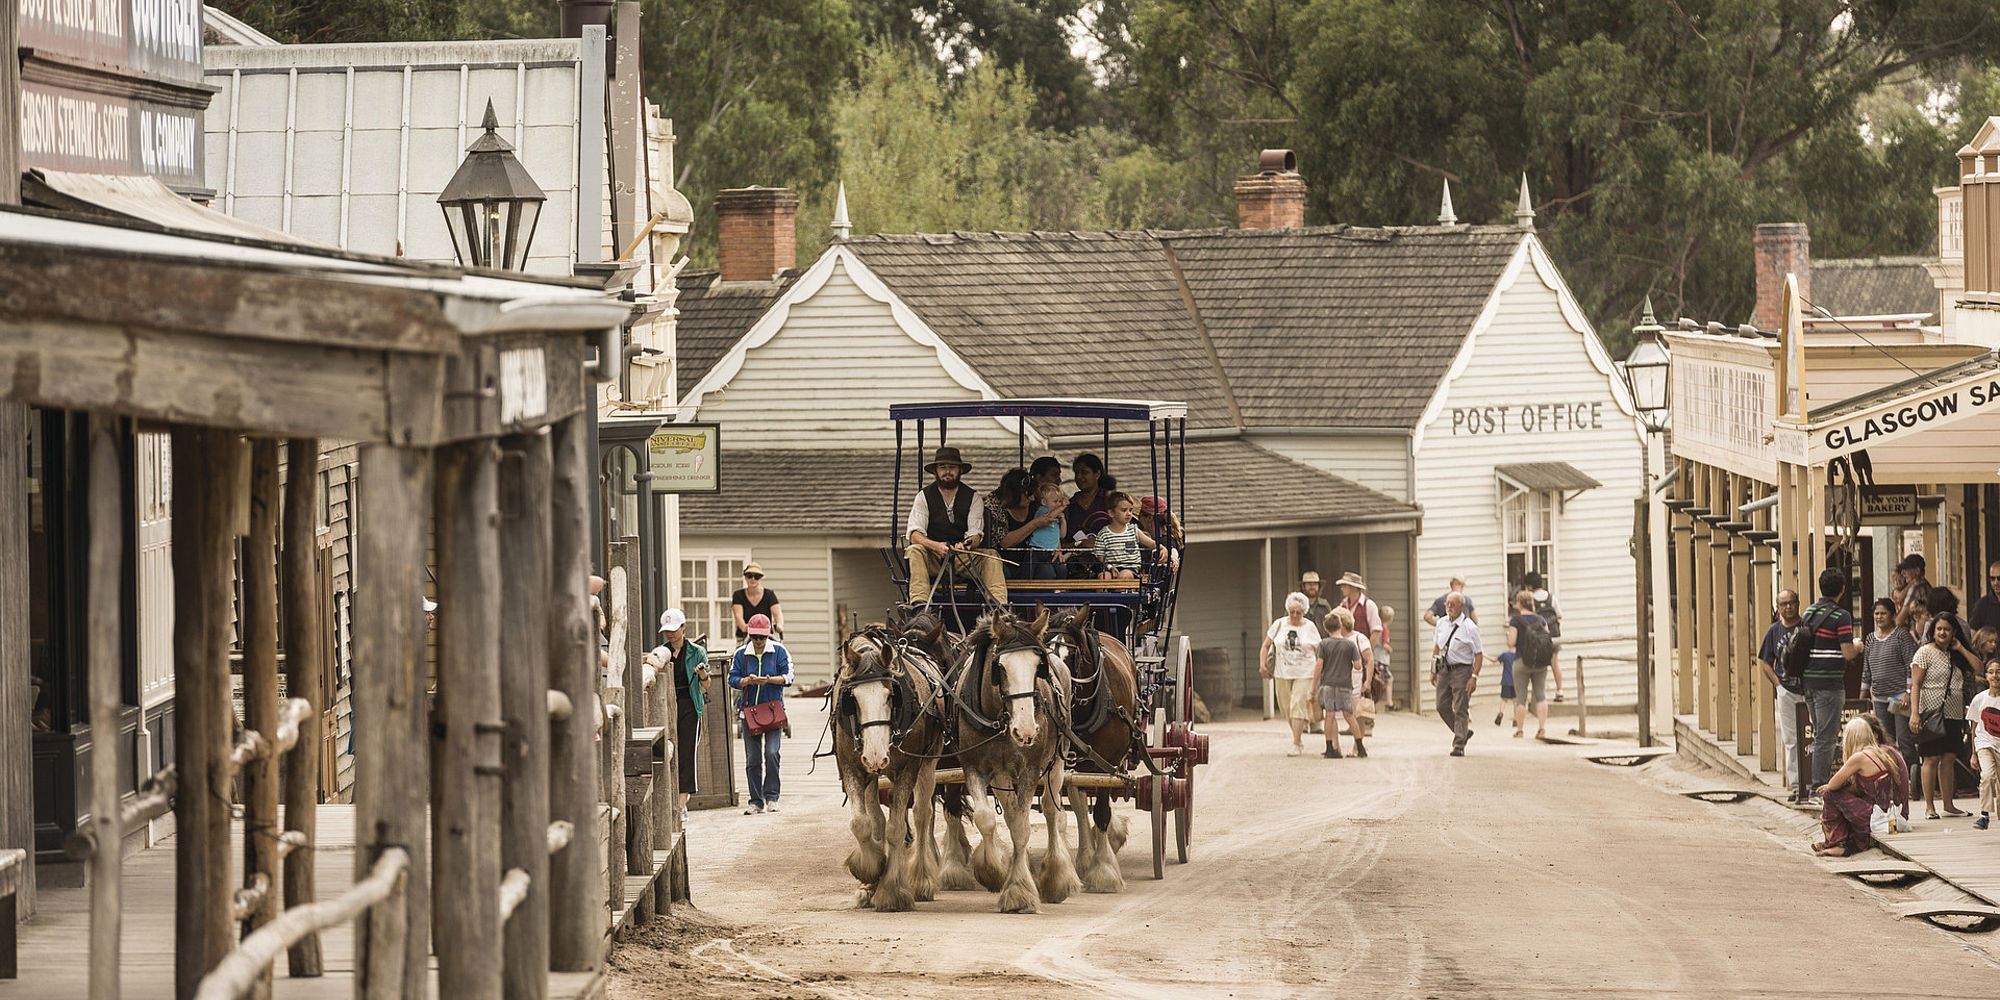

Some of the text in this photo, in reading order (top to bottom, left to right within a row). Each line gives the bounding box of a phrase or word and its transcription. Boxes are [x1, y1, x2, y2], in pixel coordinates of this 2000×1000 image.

[21, 89, 56, 153] GIBSON
[58, 95, 97, 159] STEWART
[104, 104, 129, 161] SCOTT
[140, 110, 196, 172] OIL COMPANY
[1452, 402, 1603, 436] POST OFFICE
[1729, 368, 1766, 449] BAKERY
[1825, 392, 1958, 450] GLASGOW
[1867, 504, 1908, 513] BAKERY
[1886, 496, 1911, 504] YORK
